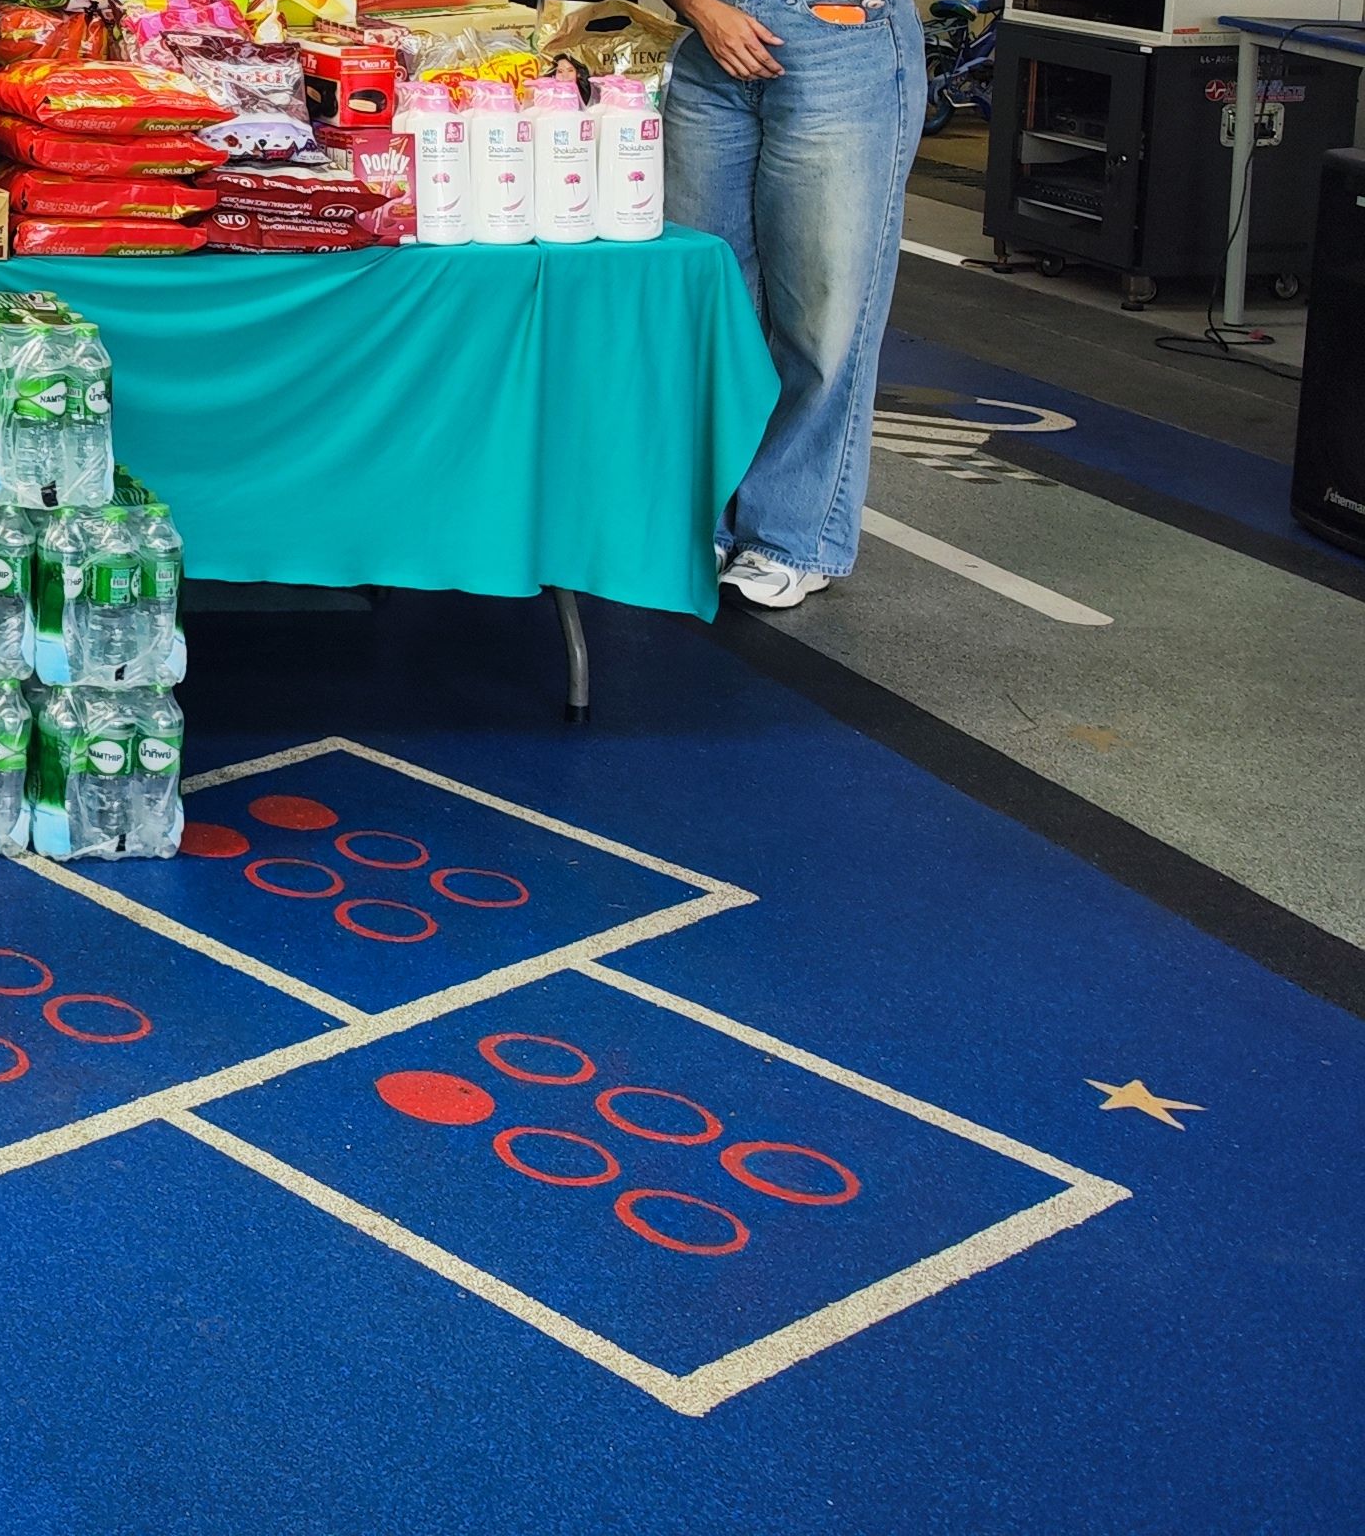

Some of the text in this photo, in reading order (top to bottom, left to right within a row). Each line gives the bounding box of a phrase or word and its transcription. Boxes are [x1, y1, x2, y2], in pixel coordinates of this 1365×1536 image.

[217, 213, 246, 225] aro
[140, 743, 172, 761] น้ำทิพย์
